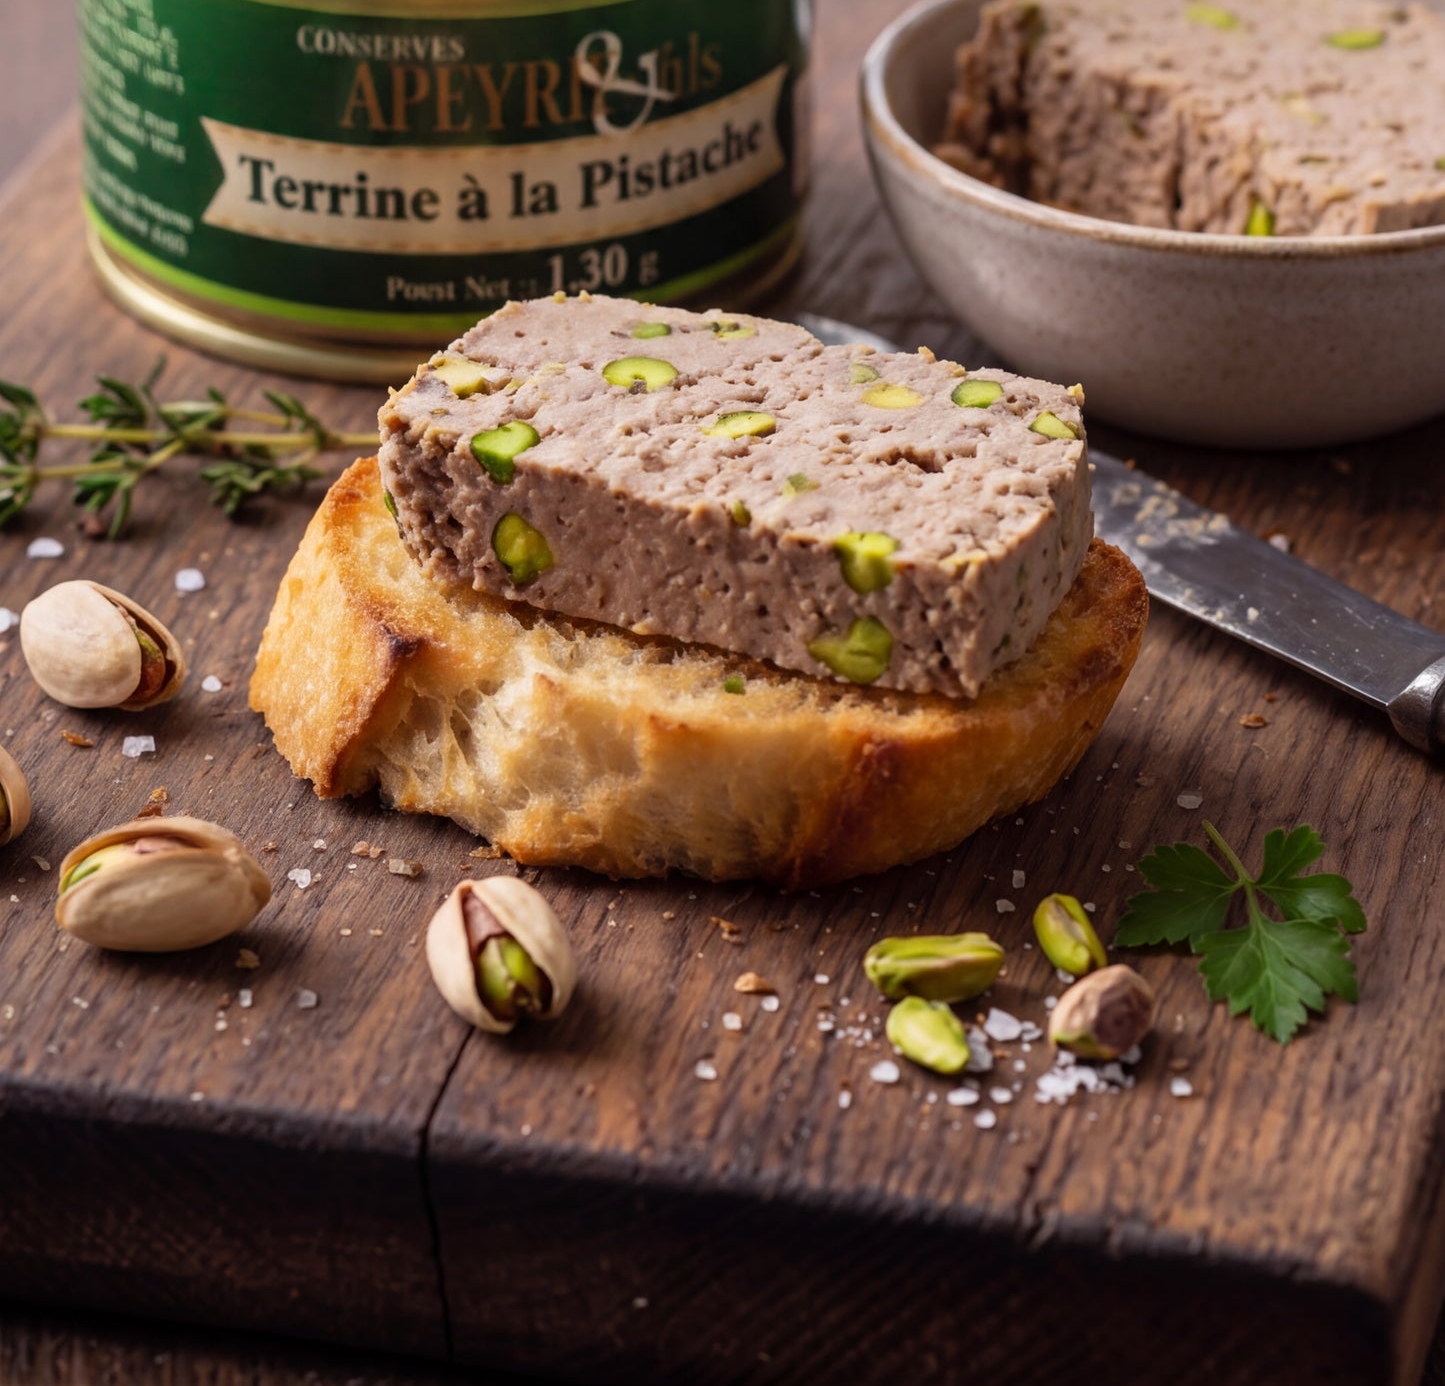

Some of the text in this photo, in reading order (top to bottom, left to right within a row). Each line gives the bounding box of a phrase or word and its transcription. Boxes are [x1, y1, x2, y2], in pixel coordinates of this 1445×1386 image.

[296, 25, 465, 62] CONSERVES
[574, 30, 676, 137] &
[239, 155, 441, 222] Terrine
[457, 174, 489, 221] à
[509, 171, 558, 216] la
[579, 118, 763, 209] Pistache
